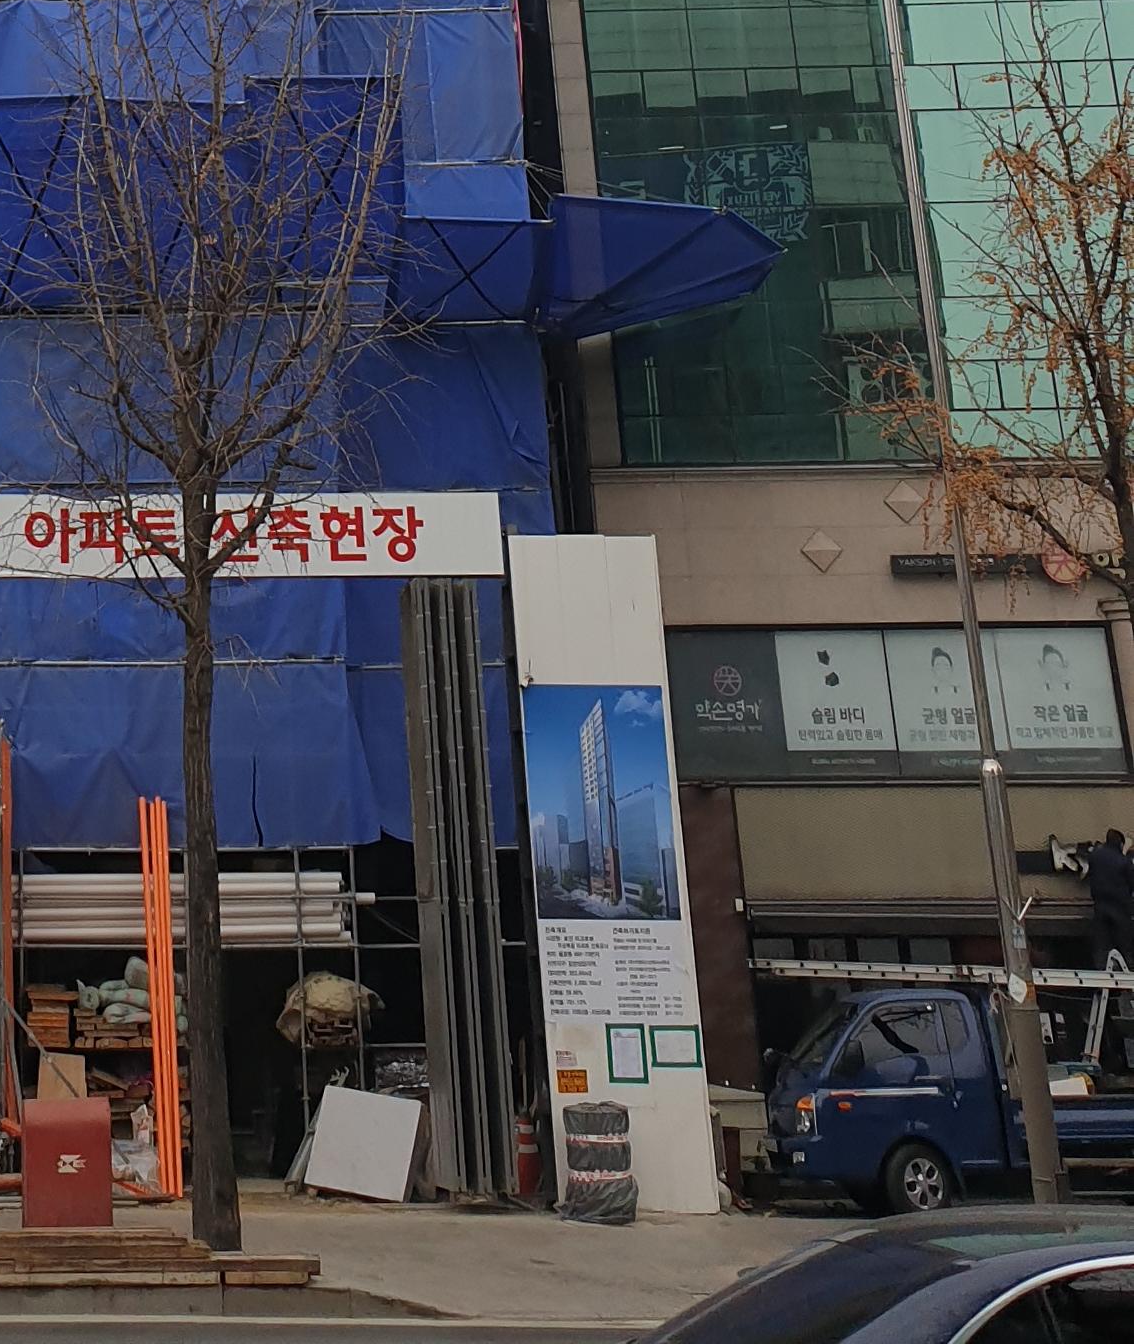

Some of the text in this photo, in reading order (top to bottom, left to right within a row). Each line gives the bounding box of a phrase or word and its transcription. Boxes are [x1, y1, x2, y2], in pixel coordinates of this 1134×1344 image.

[24, 507, 181, 564] 아파트
[211, 505, 424, 564] 신축현장
[695, 698, 763, 722] 약손명가
[811, 707, 866, 724] 슬림 바디
[1062, 704, 1089, 723] 얼굴
